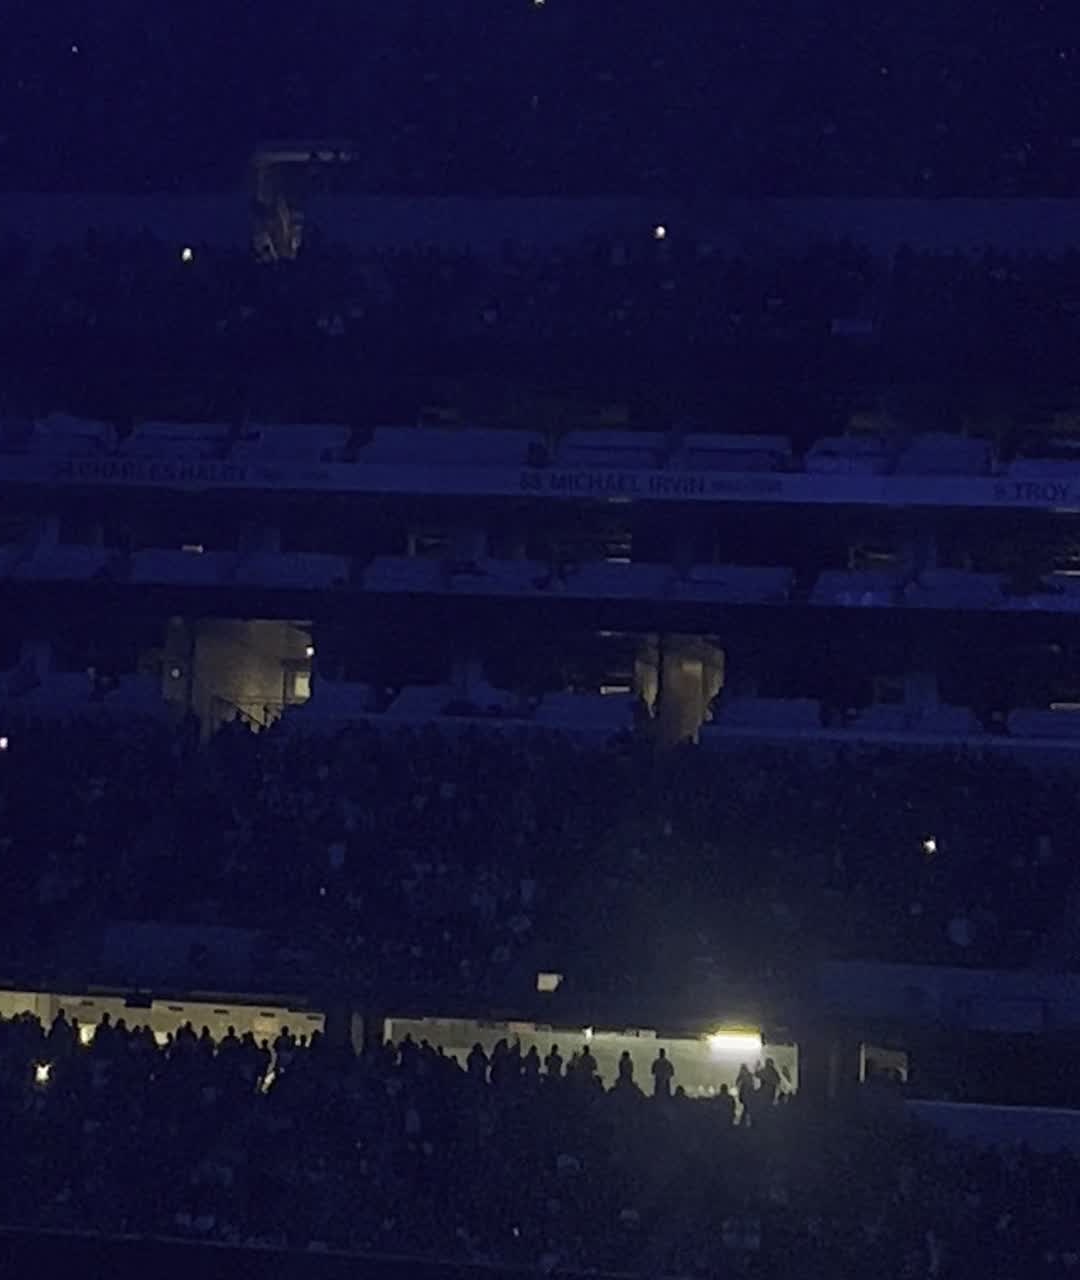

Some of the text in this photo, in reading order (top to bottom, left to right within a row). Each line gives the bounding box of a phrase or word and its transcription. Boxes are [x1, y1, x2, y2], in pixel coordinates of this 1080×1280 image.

[550, 473, 640, 493] MICHAEL
[648, 475, 705, 495] IRVIN
[1014, 482, 1069, 502] TROY
